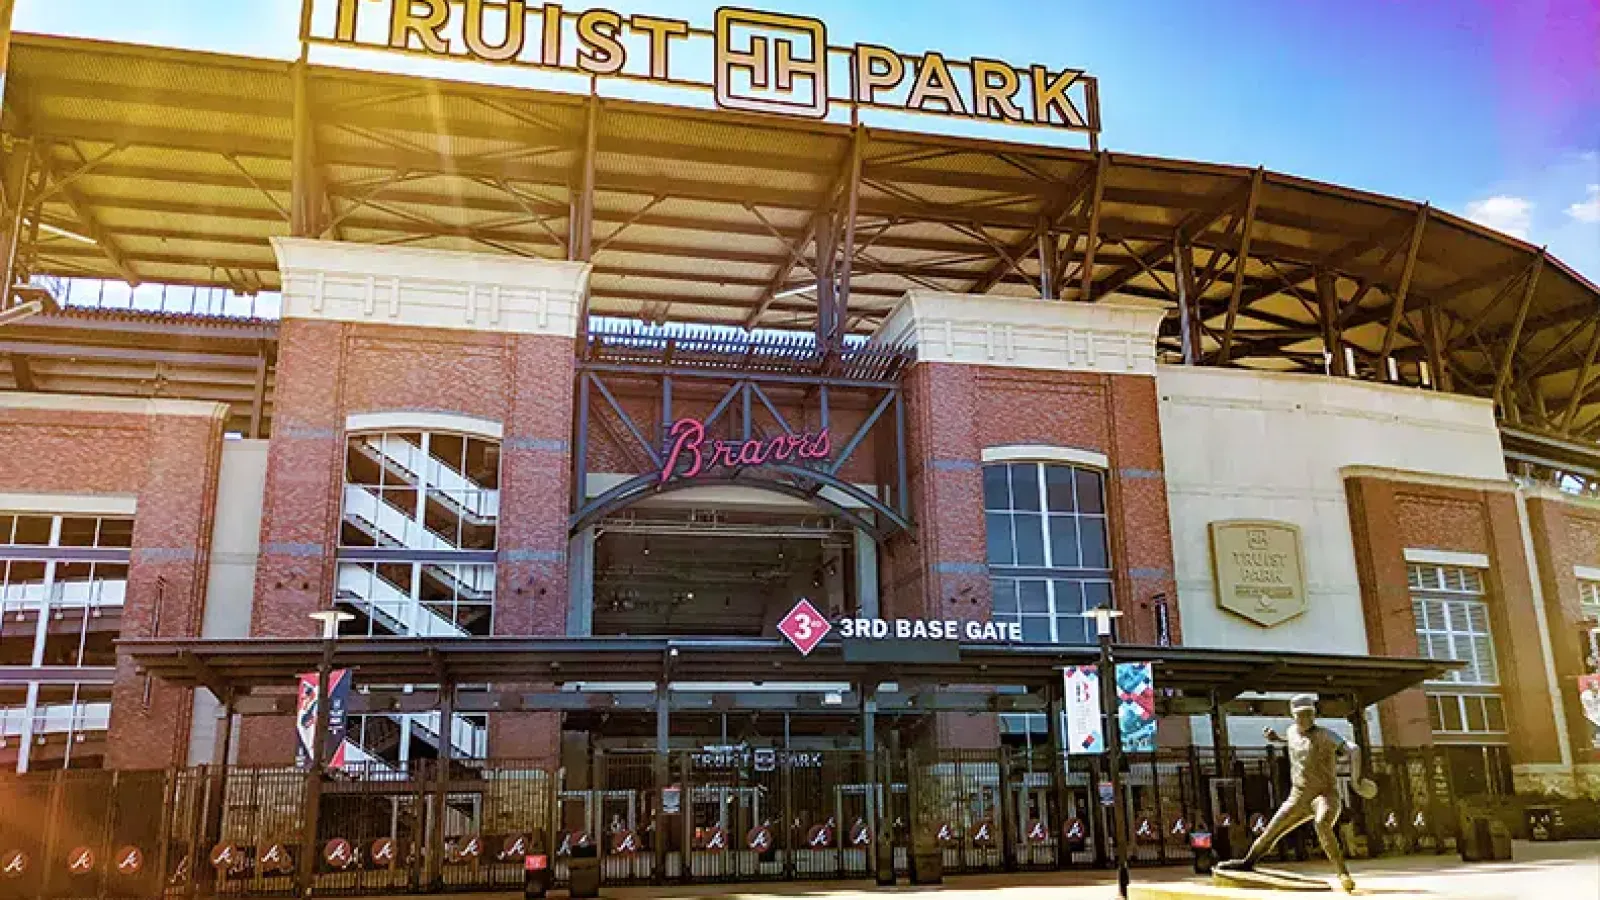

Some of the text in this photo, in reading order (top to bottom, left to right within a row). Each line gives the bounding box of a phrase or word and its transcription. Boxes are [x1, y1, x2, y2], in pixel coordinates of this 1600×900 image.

[854, 42, 1090, 127] PARK
[661, 417, 830, 483] Braves
[839, 618, 1023, 642] 3RD BASE GATE
